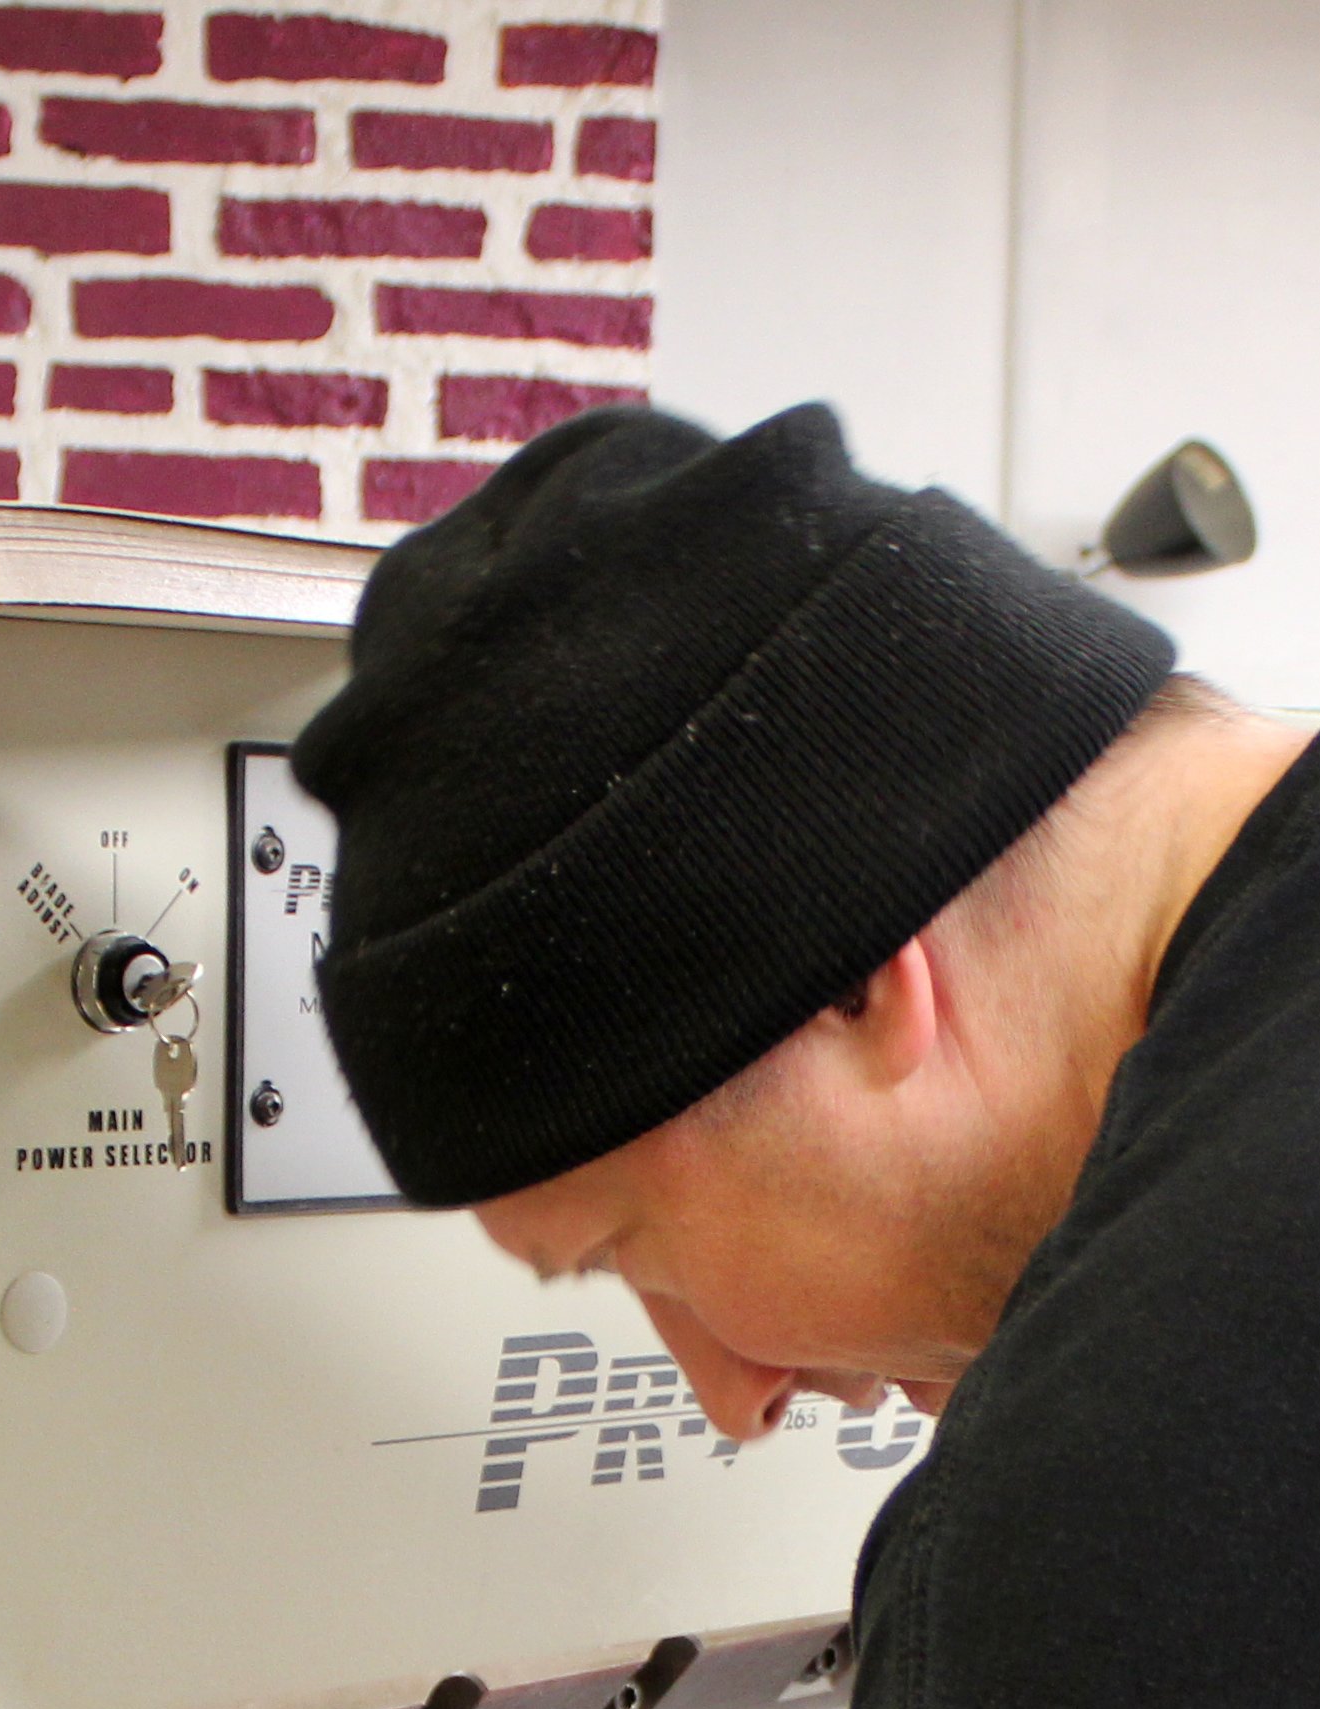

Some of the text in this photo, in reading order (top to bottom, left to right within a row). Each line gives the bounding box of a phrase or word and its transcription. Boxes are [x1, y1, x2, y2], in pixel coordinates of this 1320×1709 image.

[100, 831, 129, 848] OFF
[179, 867, 199, 894] ON
[17, 879, 70, 944] ADJUST
[88, 1110, 143, 1132] MAIN
[17, 1141, 211, 1171] POWER SELECOR
[783, 1407, 817, 1430] 265
